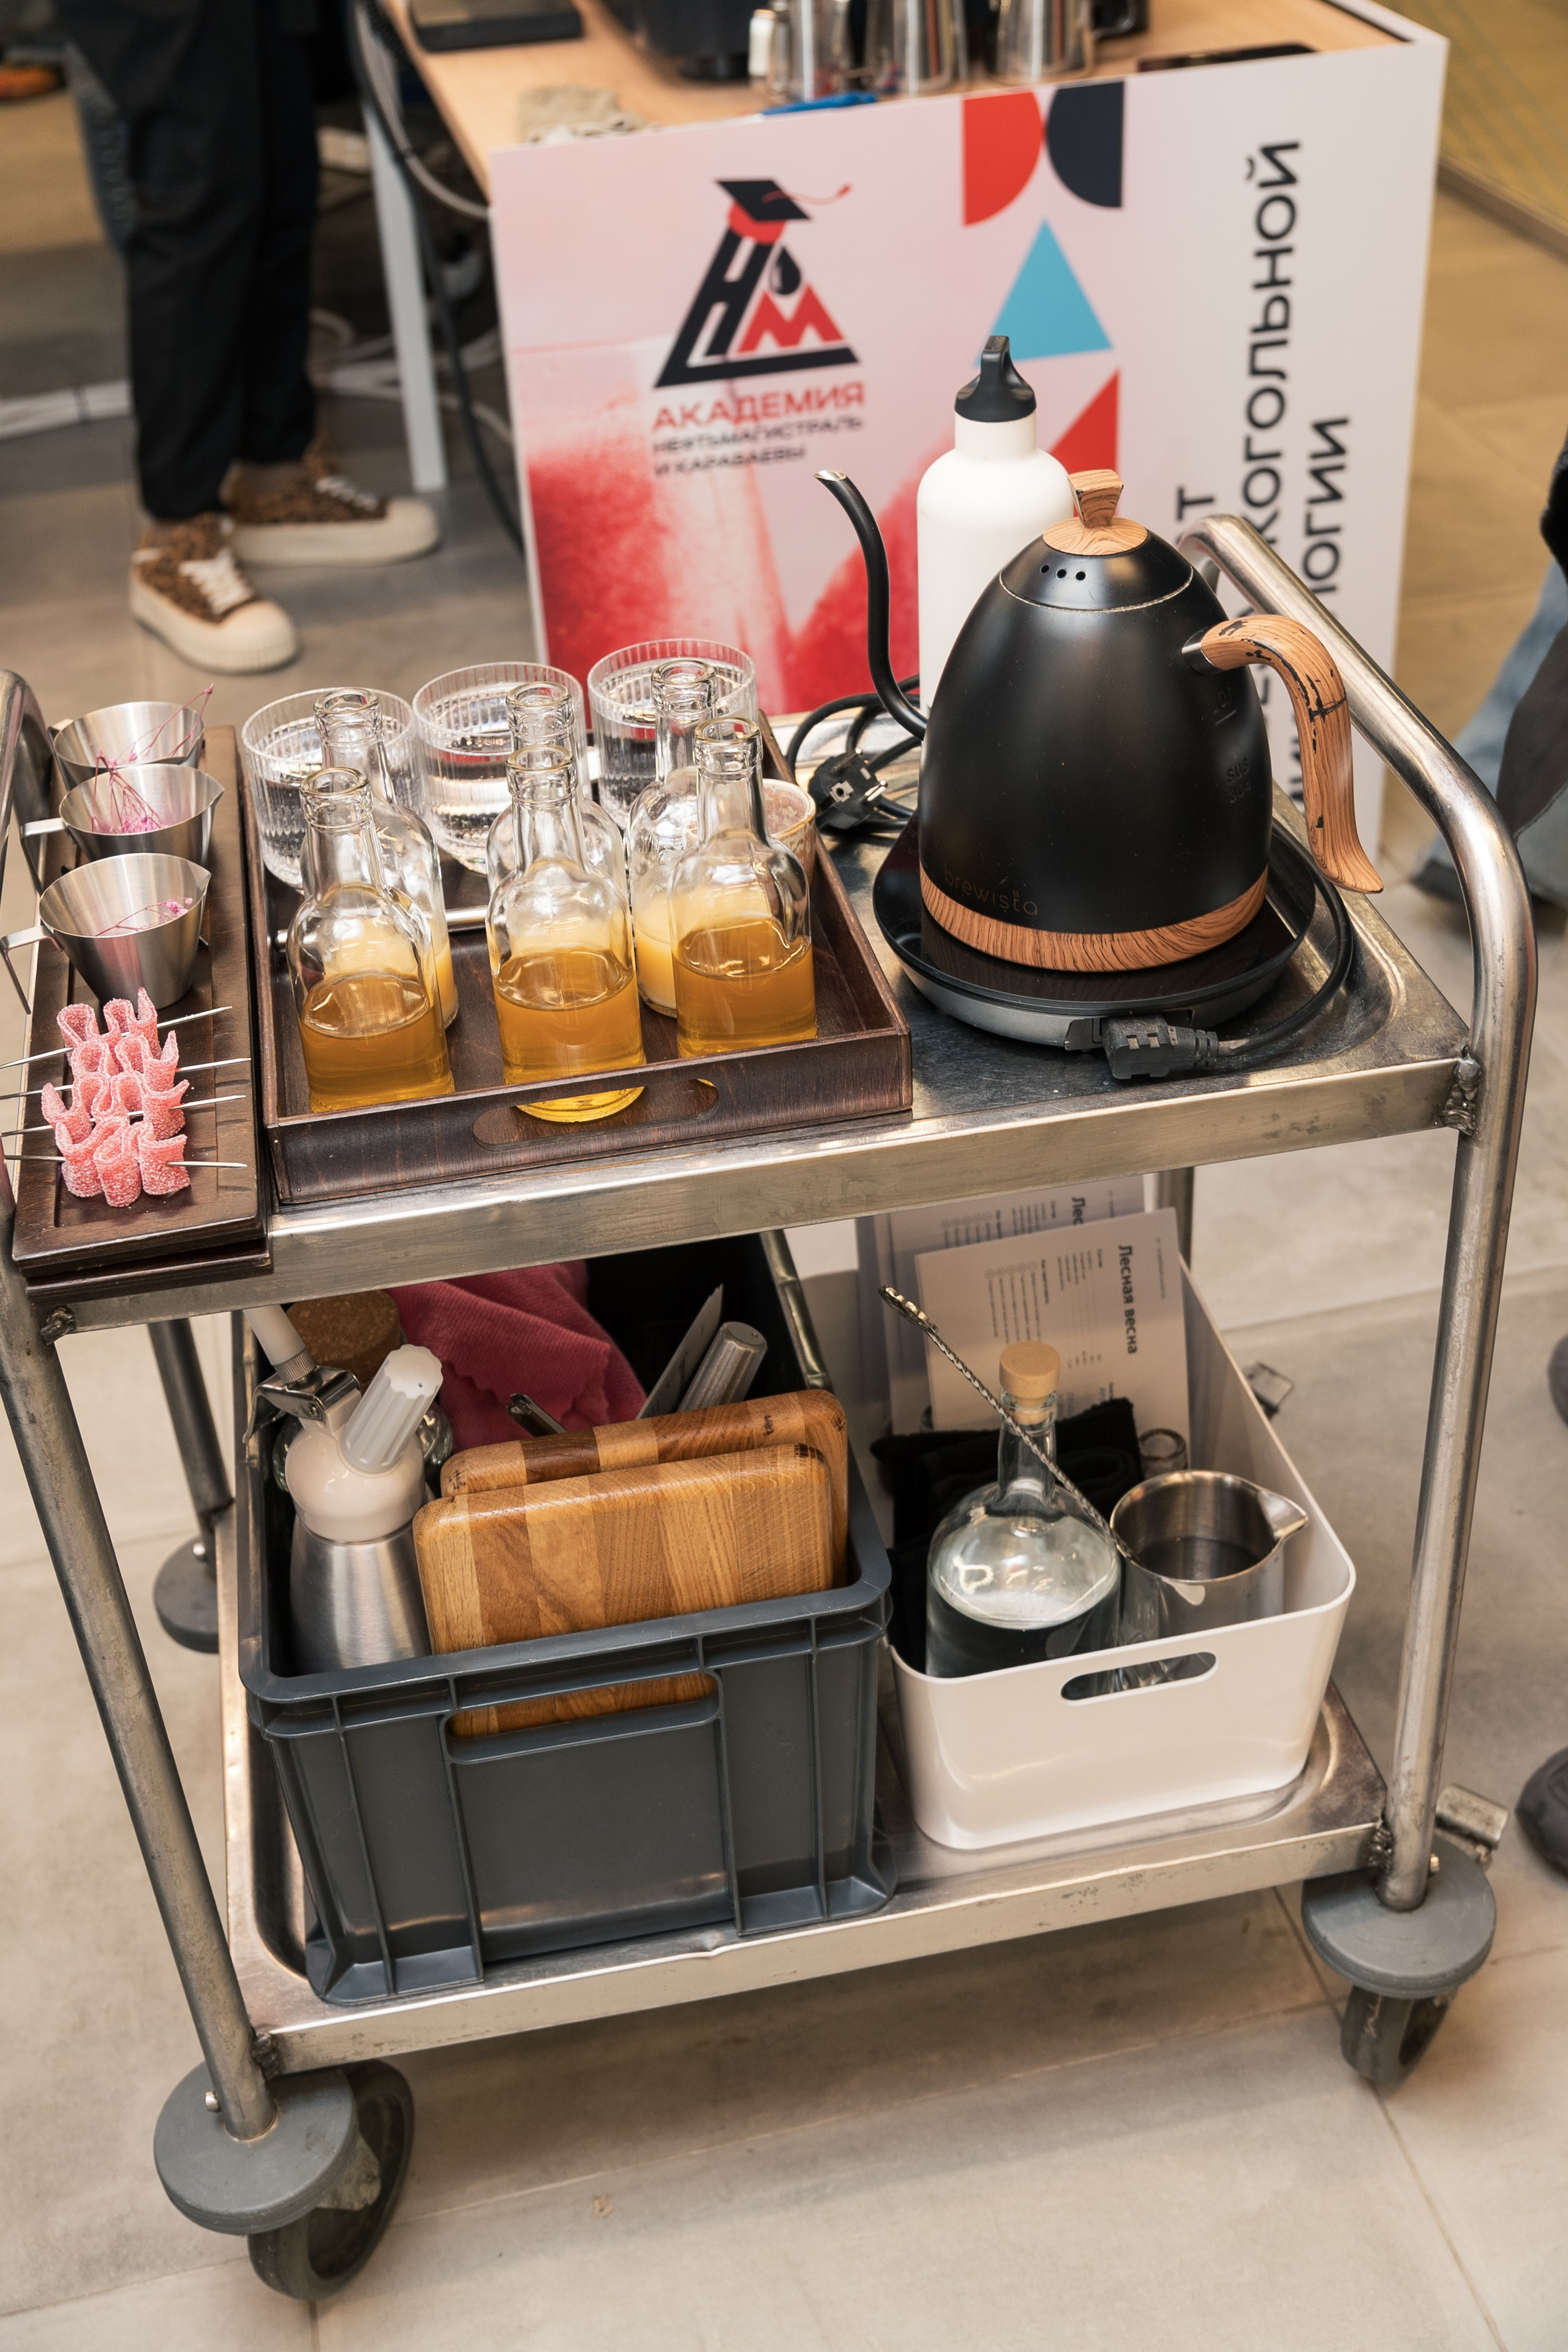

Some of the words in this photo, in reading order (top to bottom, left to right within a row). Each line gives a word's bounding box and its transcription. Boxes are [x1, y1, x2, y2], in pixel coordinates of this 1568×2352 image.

[1237, 140, 1301, 585] КОГОЛЬНОЙ
[653, 380, 864, 431] АКАДЕМИЯ
[1177, 485, 1215, 528] Т
[944, 861, 1038, 915] brewista
[1071, 1196, 1085, 1225] Лес
[1118, 1244, 1133, 1304] Лесная
[1125, 1309, 1137, 1354] весна
